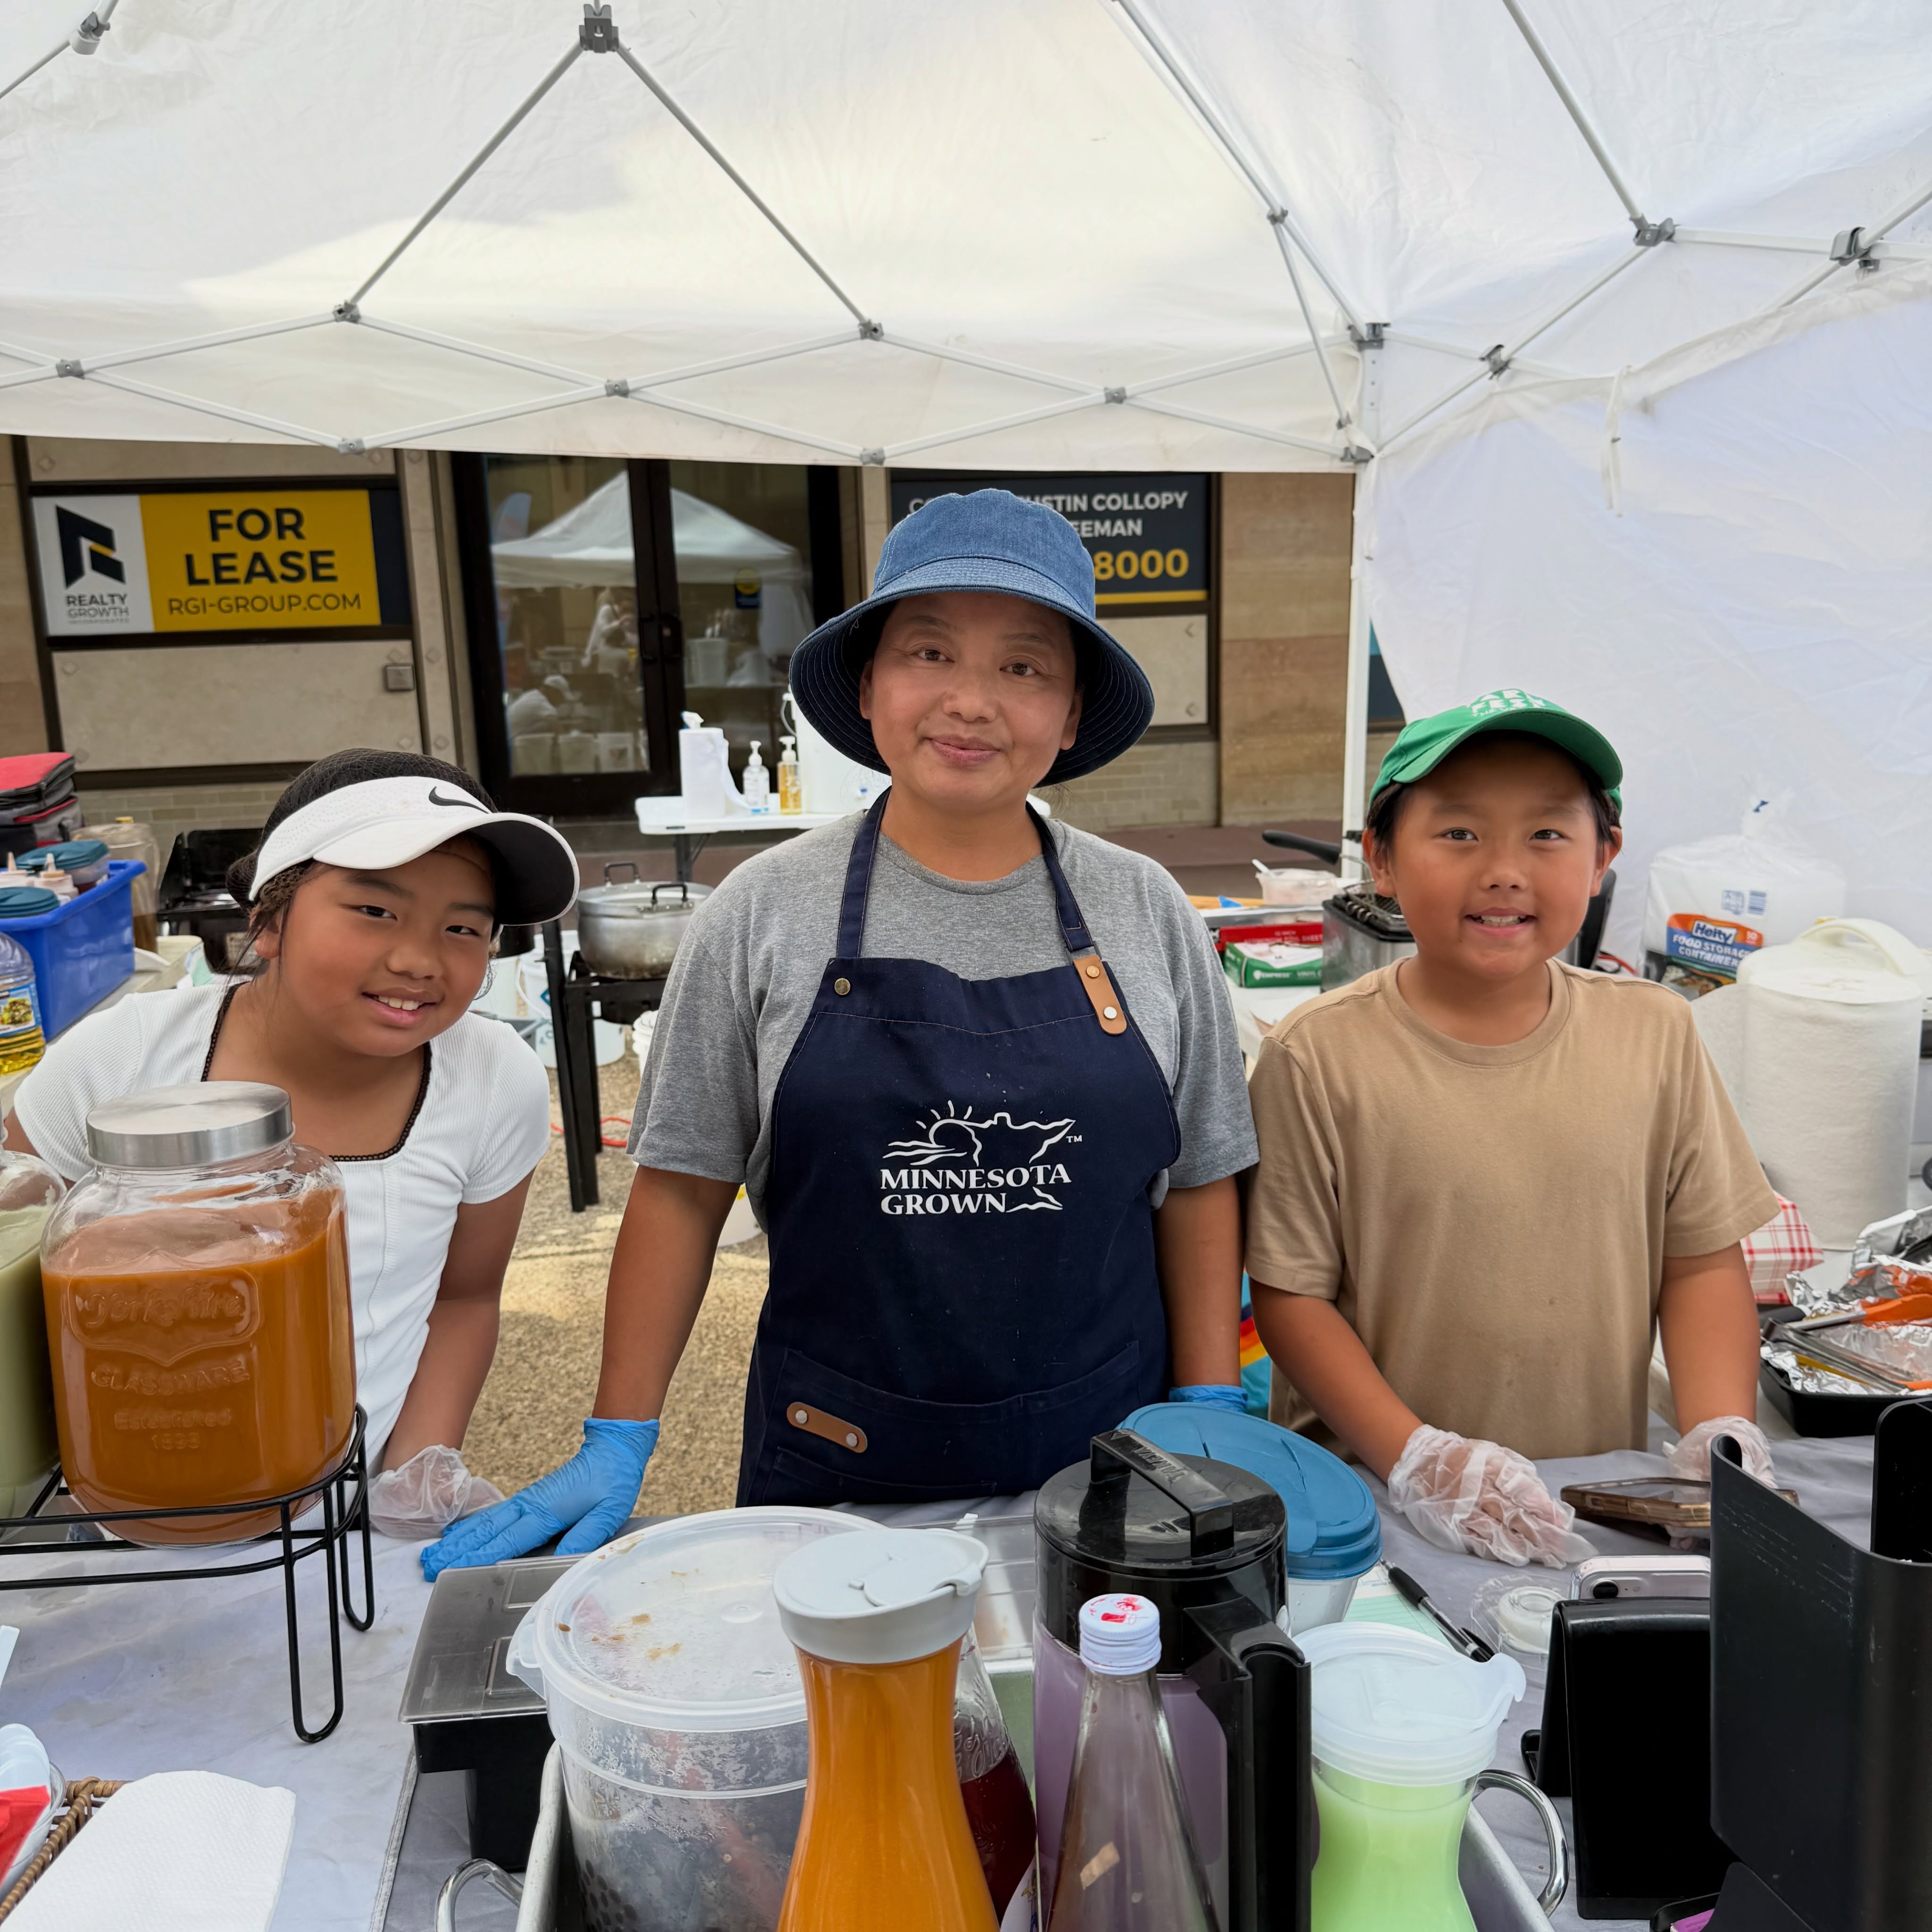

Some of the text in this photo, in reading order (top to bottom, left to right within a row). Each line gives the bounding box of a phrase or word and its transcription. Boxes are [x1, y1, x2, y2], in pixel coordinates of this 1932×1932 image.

[1091, 491, 1188, 510] COLLOPY
[209, 508, 306, 541] FOR
[185, 550, 338, 586] LEASE
[66, 593, 127, 607] REALTY
[168, 593, 361, 615] RGI-GROUP.COM
[68, 607, 129, 619] GROWTH
[1672, 934, 1703, 949] FOOD
[880, 1163, 1072, 1190] MINNESOTA
[881, 1193, 1007, 1215] GROWN
[92, 1359, 250, 1396] GLASSWARE
